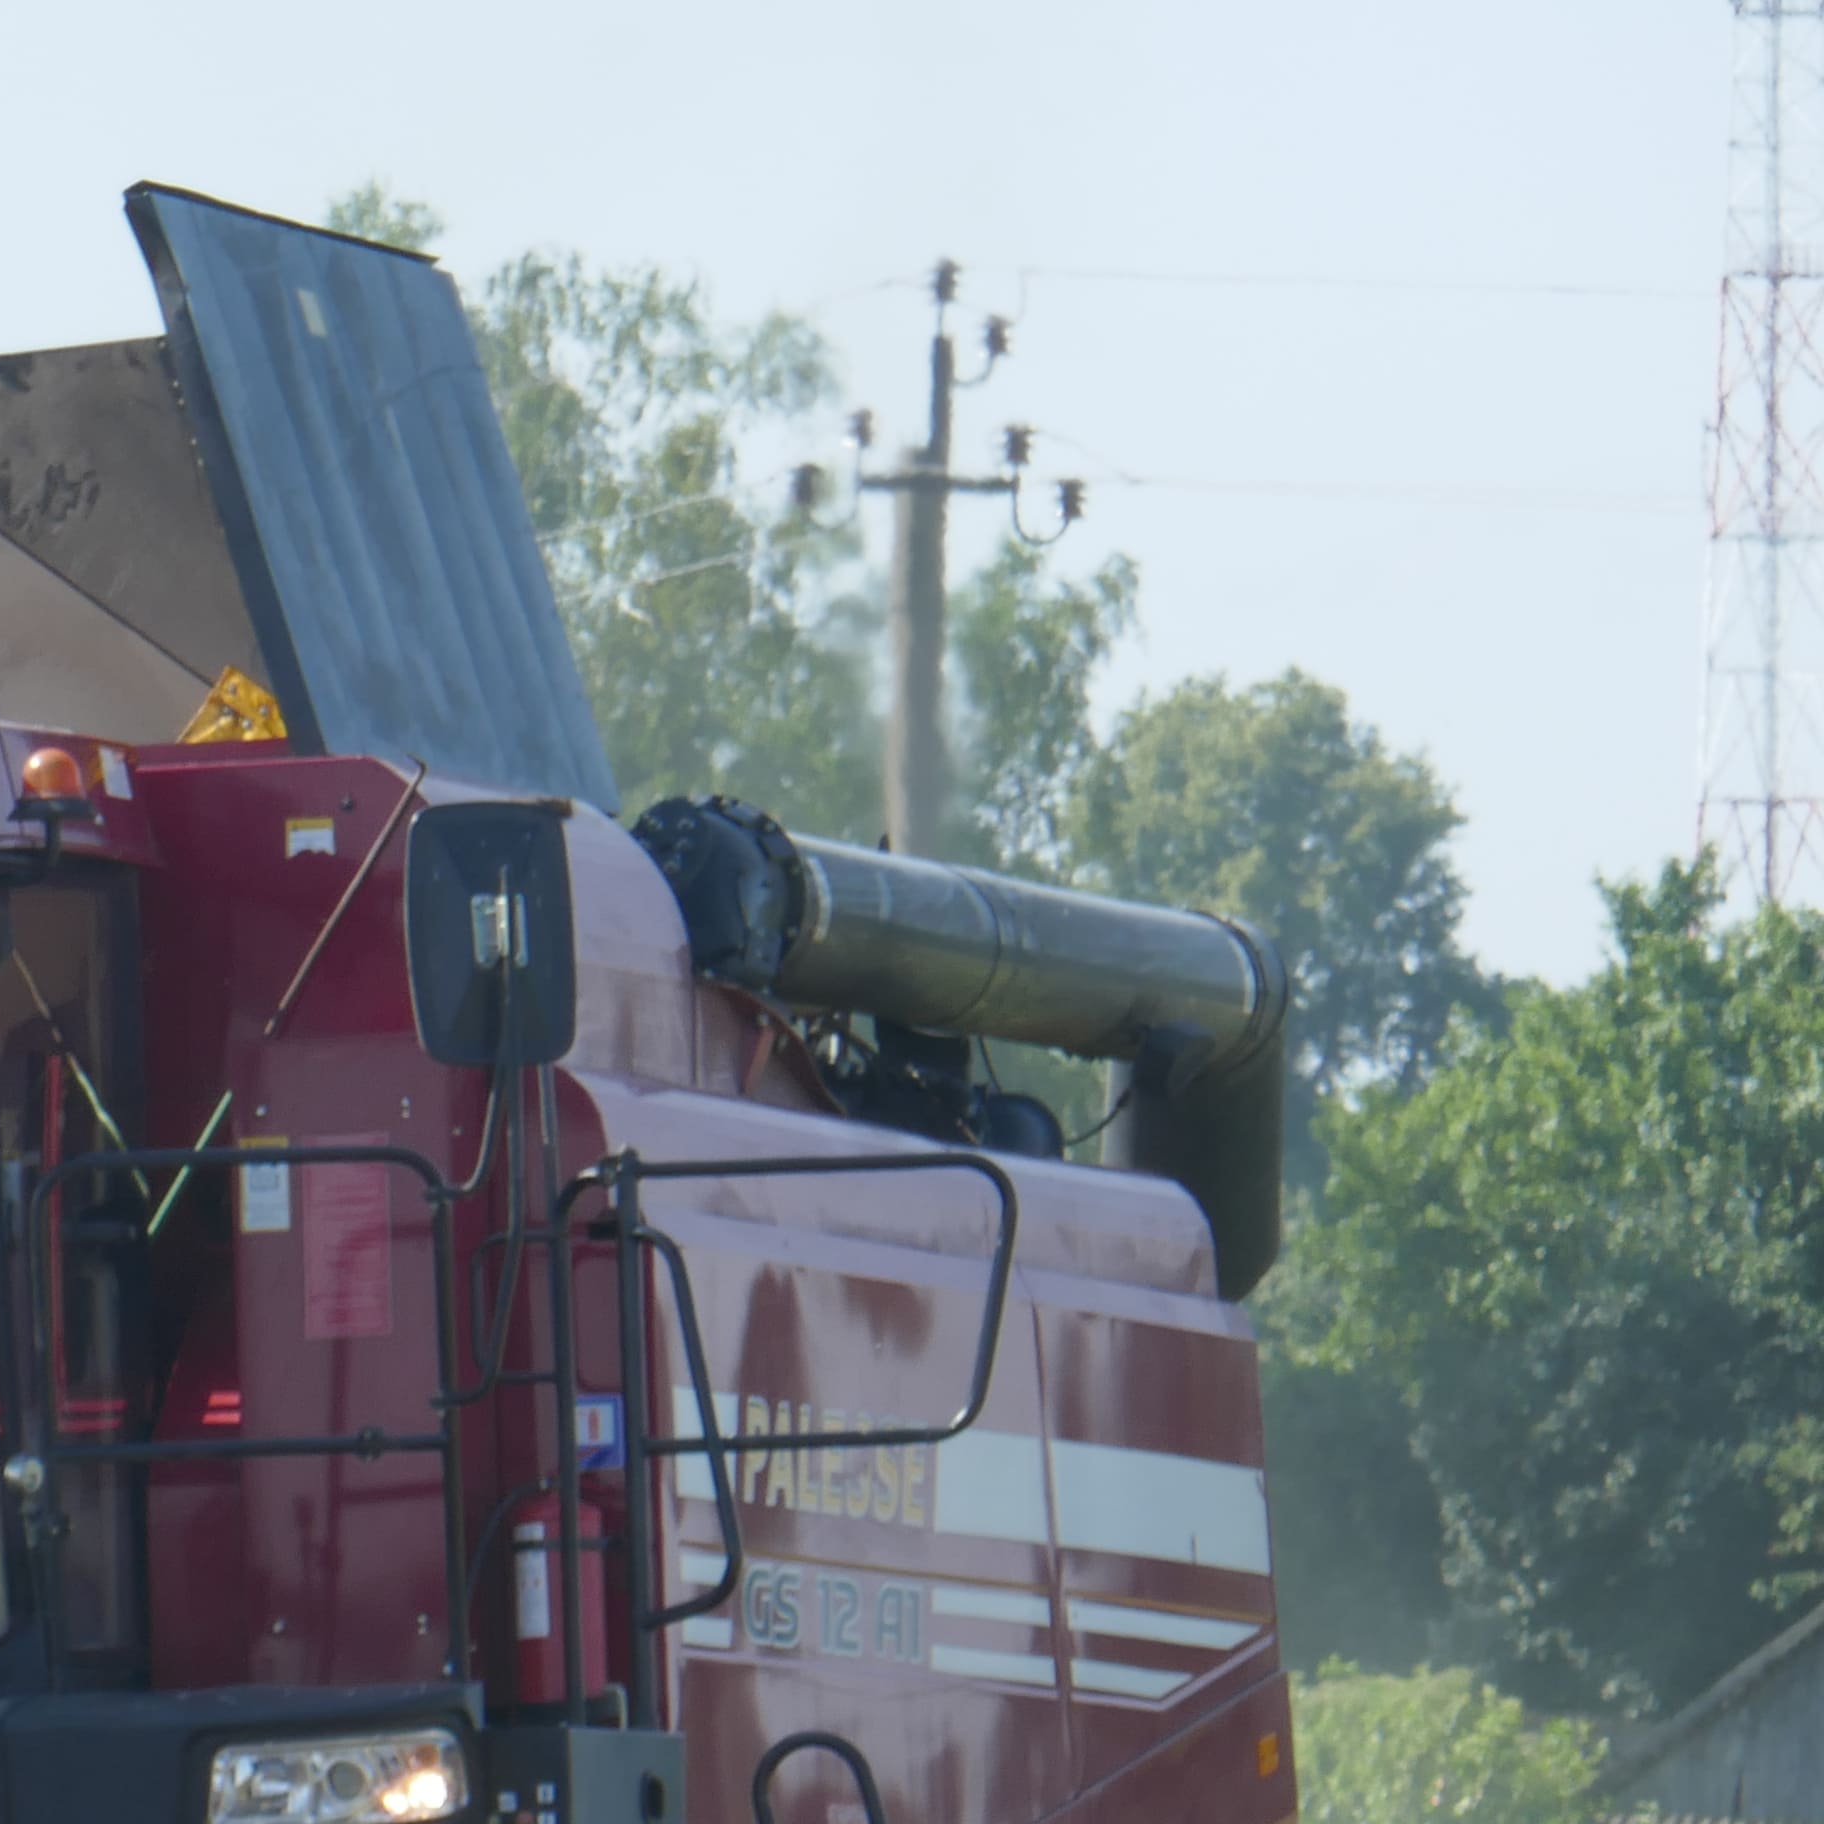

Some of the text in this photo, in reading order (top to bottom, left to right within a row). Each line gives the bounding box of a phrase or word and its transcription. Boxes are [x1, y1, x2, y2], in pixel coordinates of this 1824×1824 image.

[742, 1394, 929, 1527] PALESSE
[744, 1563, 924, 1664] GS 12 A1
